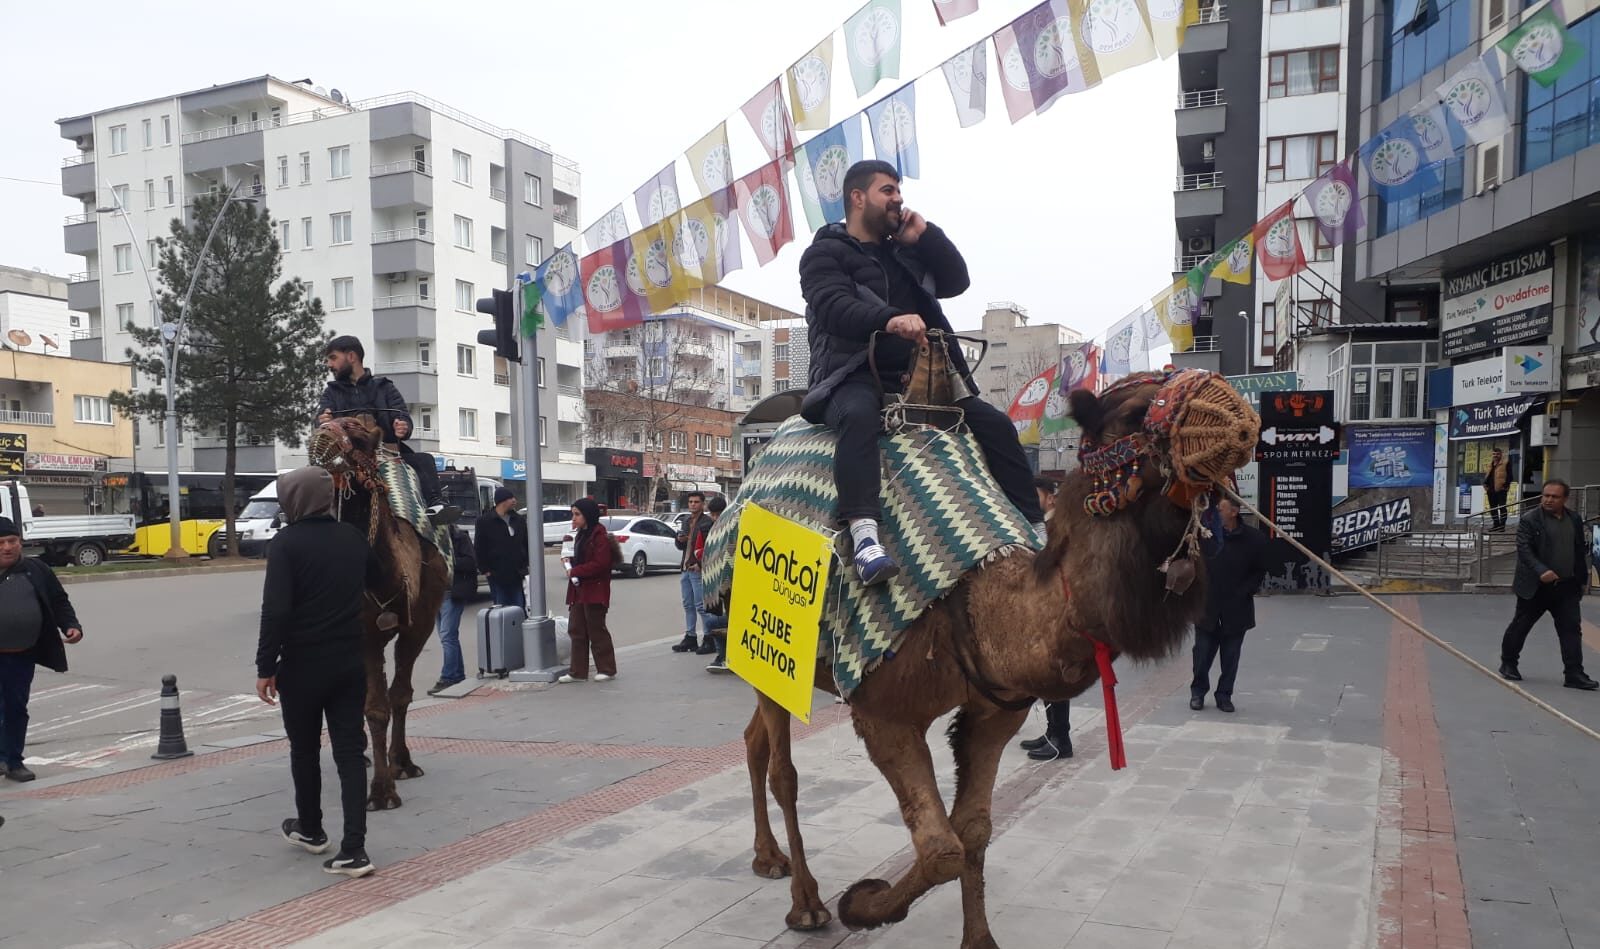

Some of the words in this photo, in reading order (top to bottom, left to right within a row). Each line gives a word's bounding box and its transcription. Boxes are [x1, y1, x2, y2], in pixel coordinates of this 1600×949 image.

[1505, 283, 1550, 305] vodafone
[1462, 378, 1475, 389] Türk
[1473, 406, 1493, 420] Türk
[41, 455, 65, 464] KURAL
[68, 456, 94, 465] EMLAK
[1263, 451, 1289, 459] SPOR
[1332, 498, 1411, 535] BEDAVA
[1348, 532, 1362, 547] EV
[741, 535, 822, 605] avantaj
[772, 578, 808, 609] Dünyası
[750, 604, 792, 645] 2.ŞUBE
[741, 629, 796, 680] AÇILIYOR
